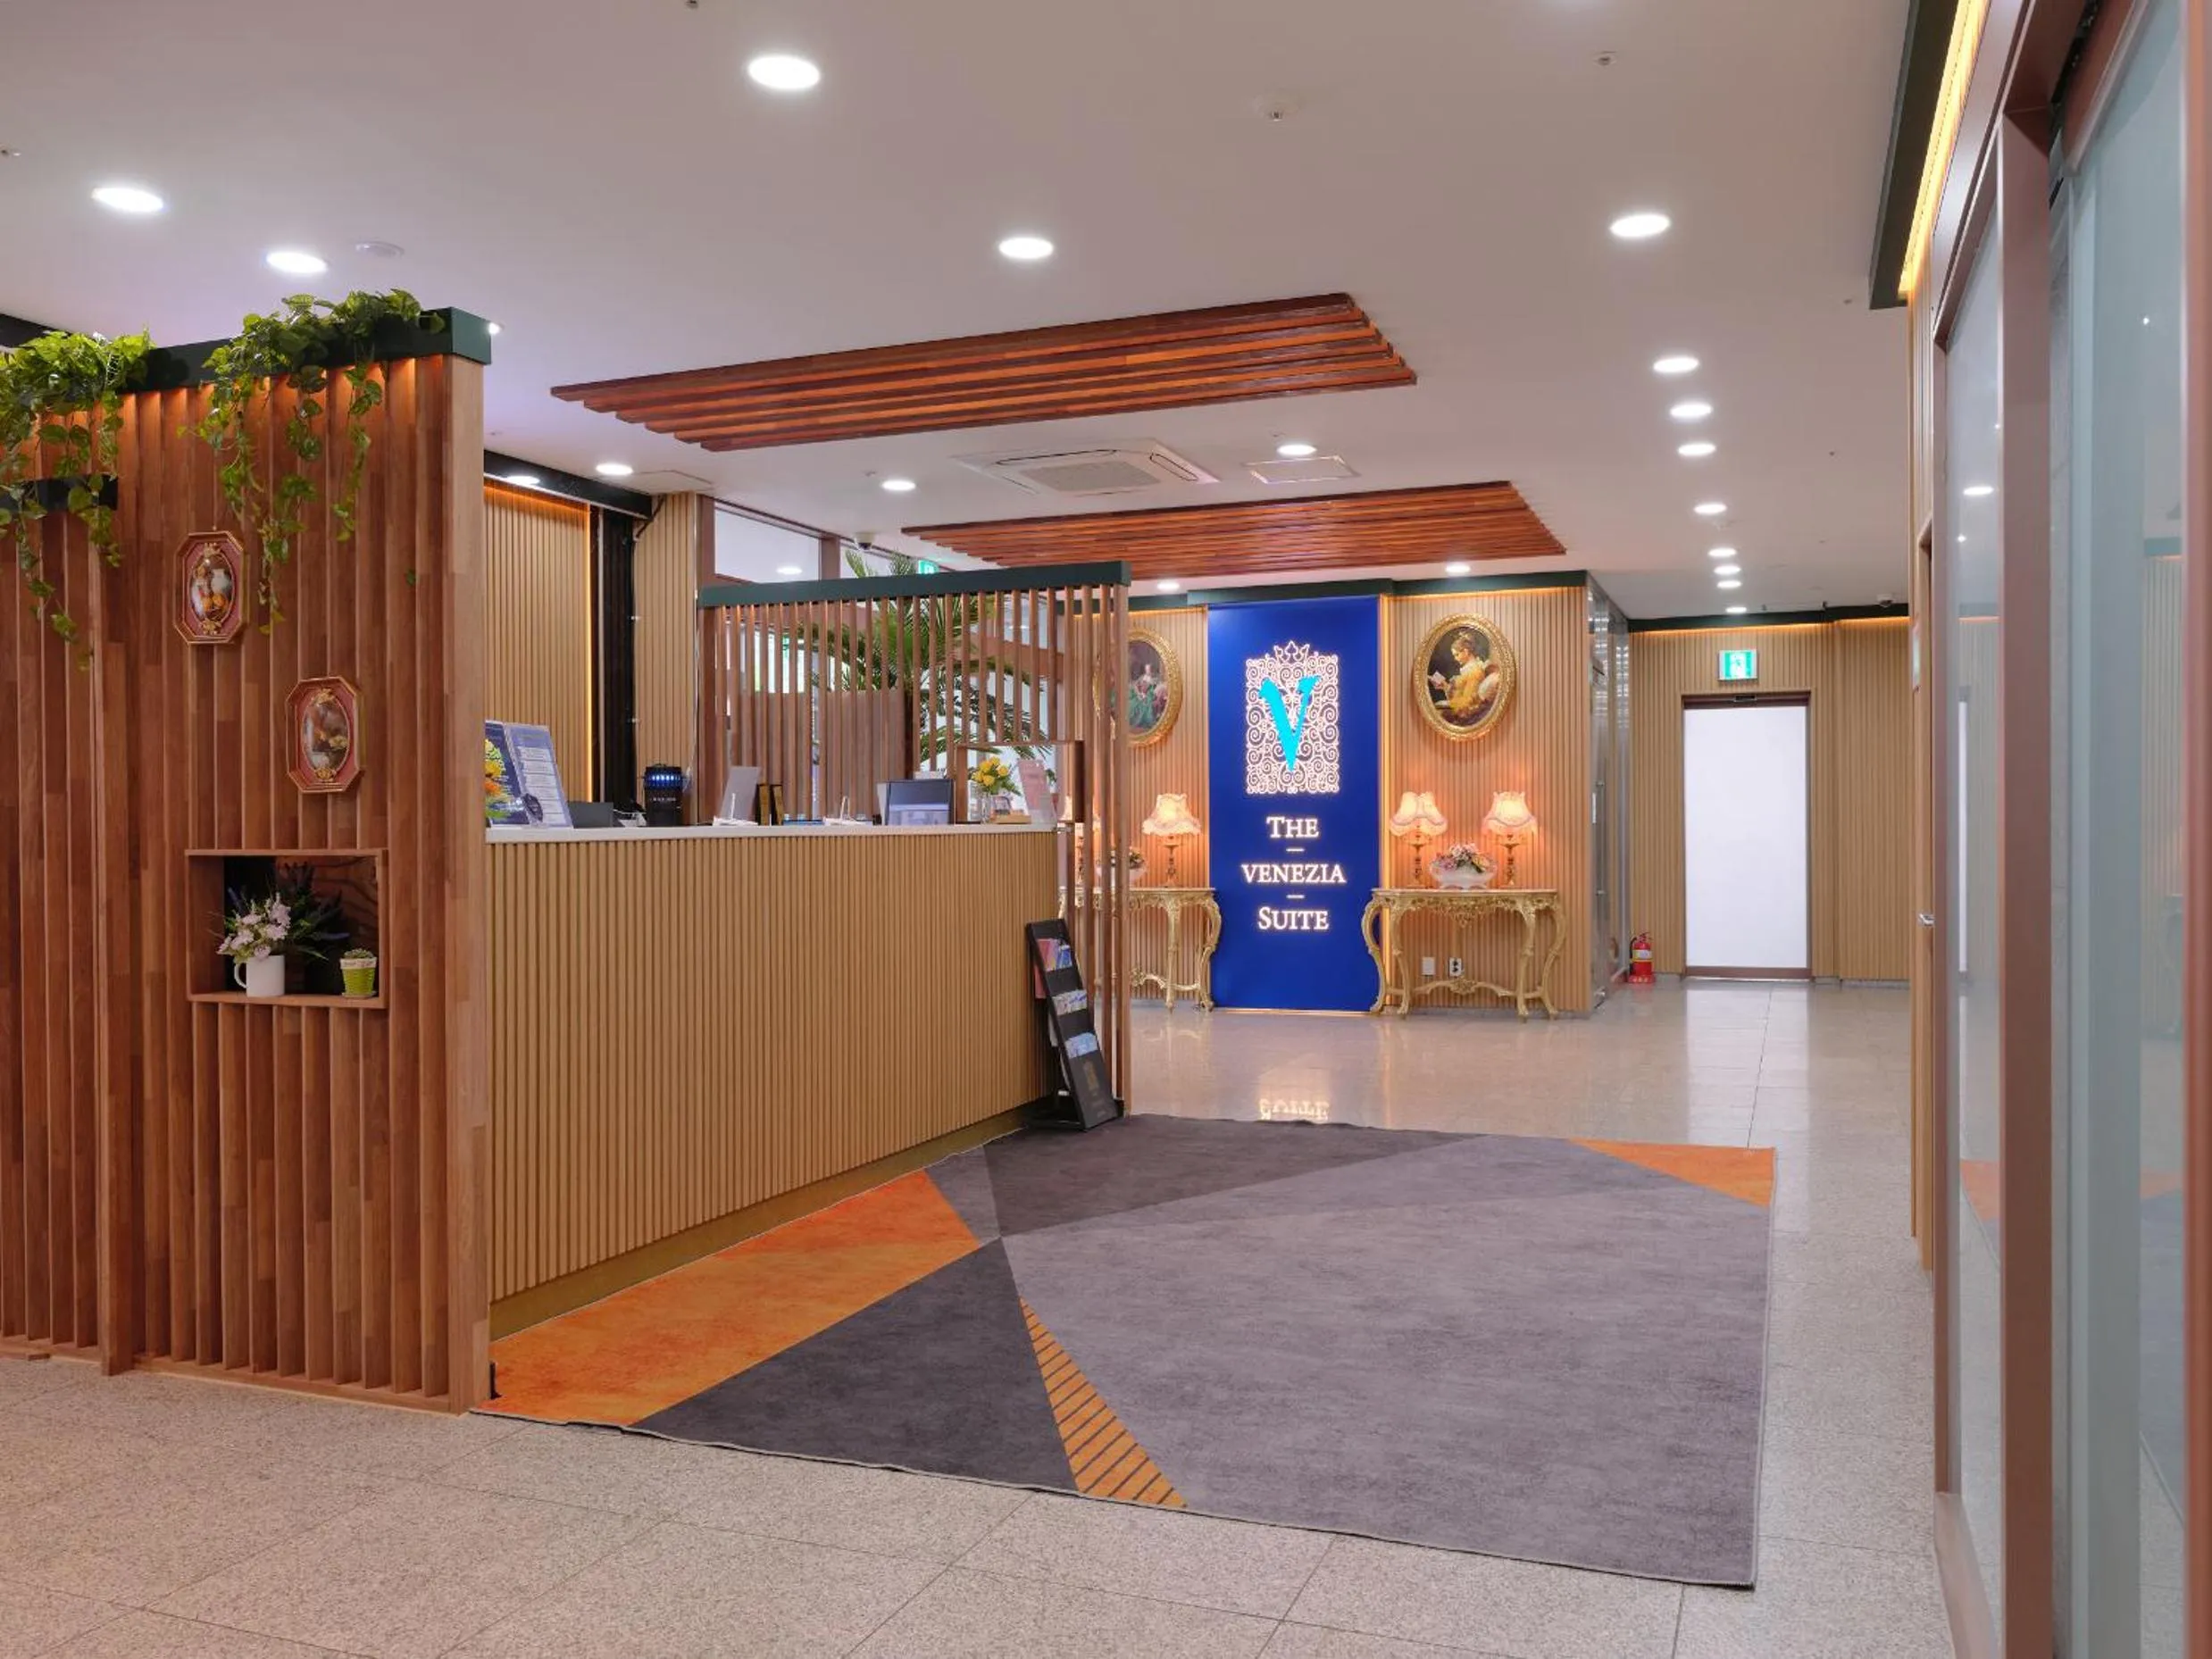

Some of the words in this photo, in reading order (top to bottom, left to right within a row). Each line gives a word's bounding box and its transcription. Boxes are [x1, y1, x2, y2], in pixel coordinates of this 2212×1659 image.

[1258, 674, 1322, 772] V
[1265, 815, 1320, 838] THE
[1240, 863, 1347, 884] VENEZIA
[1257, 905, 1330, 930] SUITE
